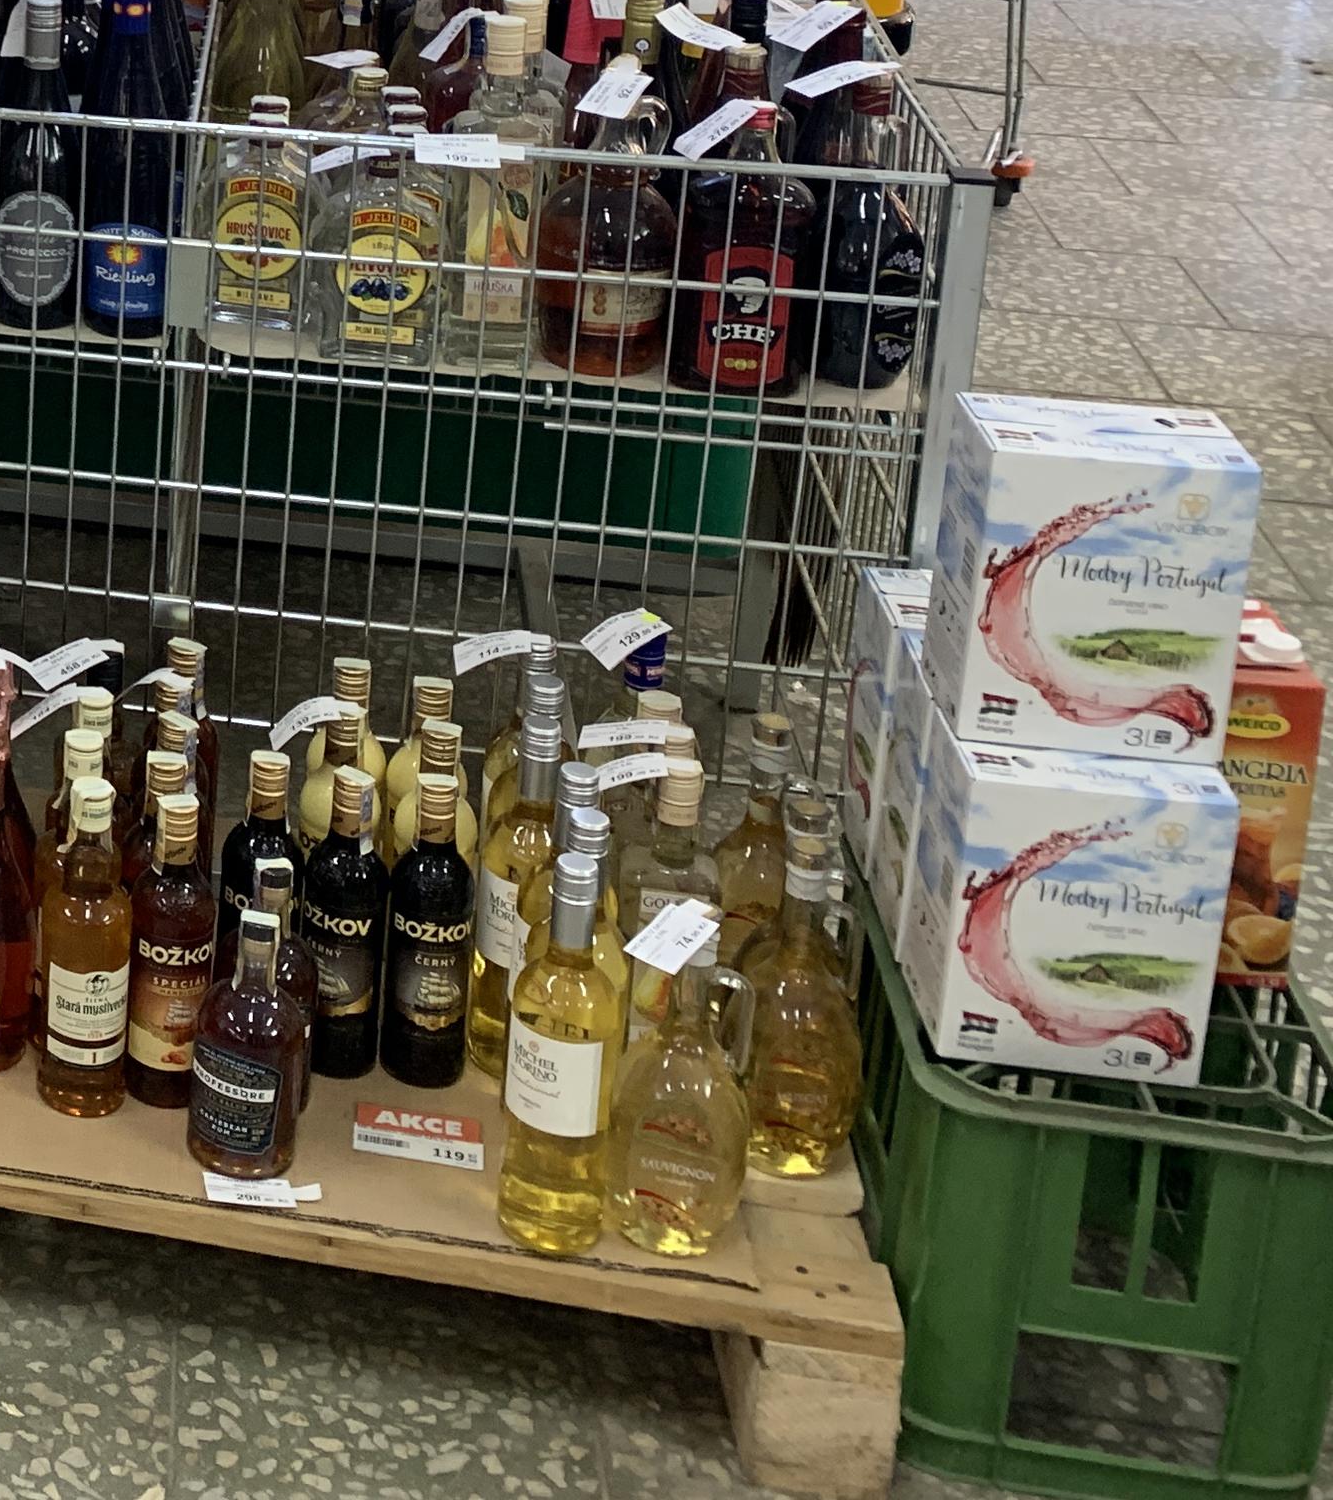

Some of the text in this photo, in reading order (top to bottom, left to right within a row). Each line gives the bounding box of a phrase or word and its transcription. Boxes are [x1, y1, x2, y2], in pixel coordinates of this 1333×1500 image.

[1139, 554, 1228, 599] Portugal
[1217, 759, 1309, 785] ANGRIA
[304, 901, 373, 937] OŽKOV
[414, 954, 457, 968] ČERNÝ
[152, 974, 207, 989] SPECIÁL
[373, 1108, 465, 1137] AKCE
[432, 1146, 466, 1164] 119
[639, 1156, 718, 1185] SAUVIGNON
